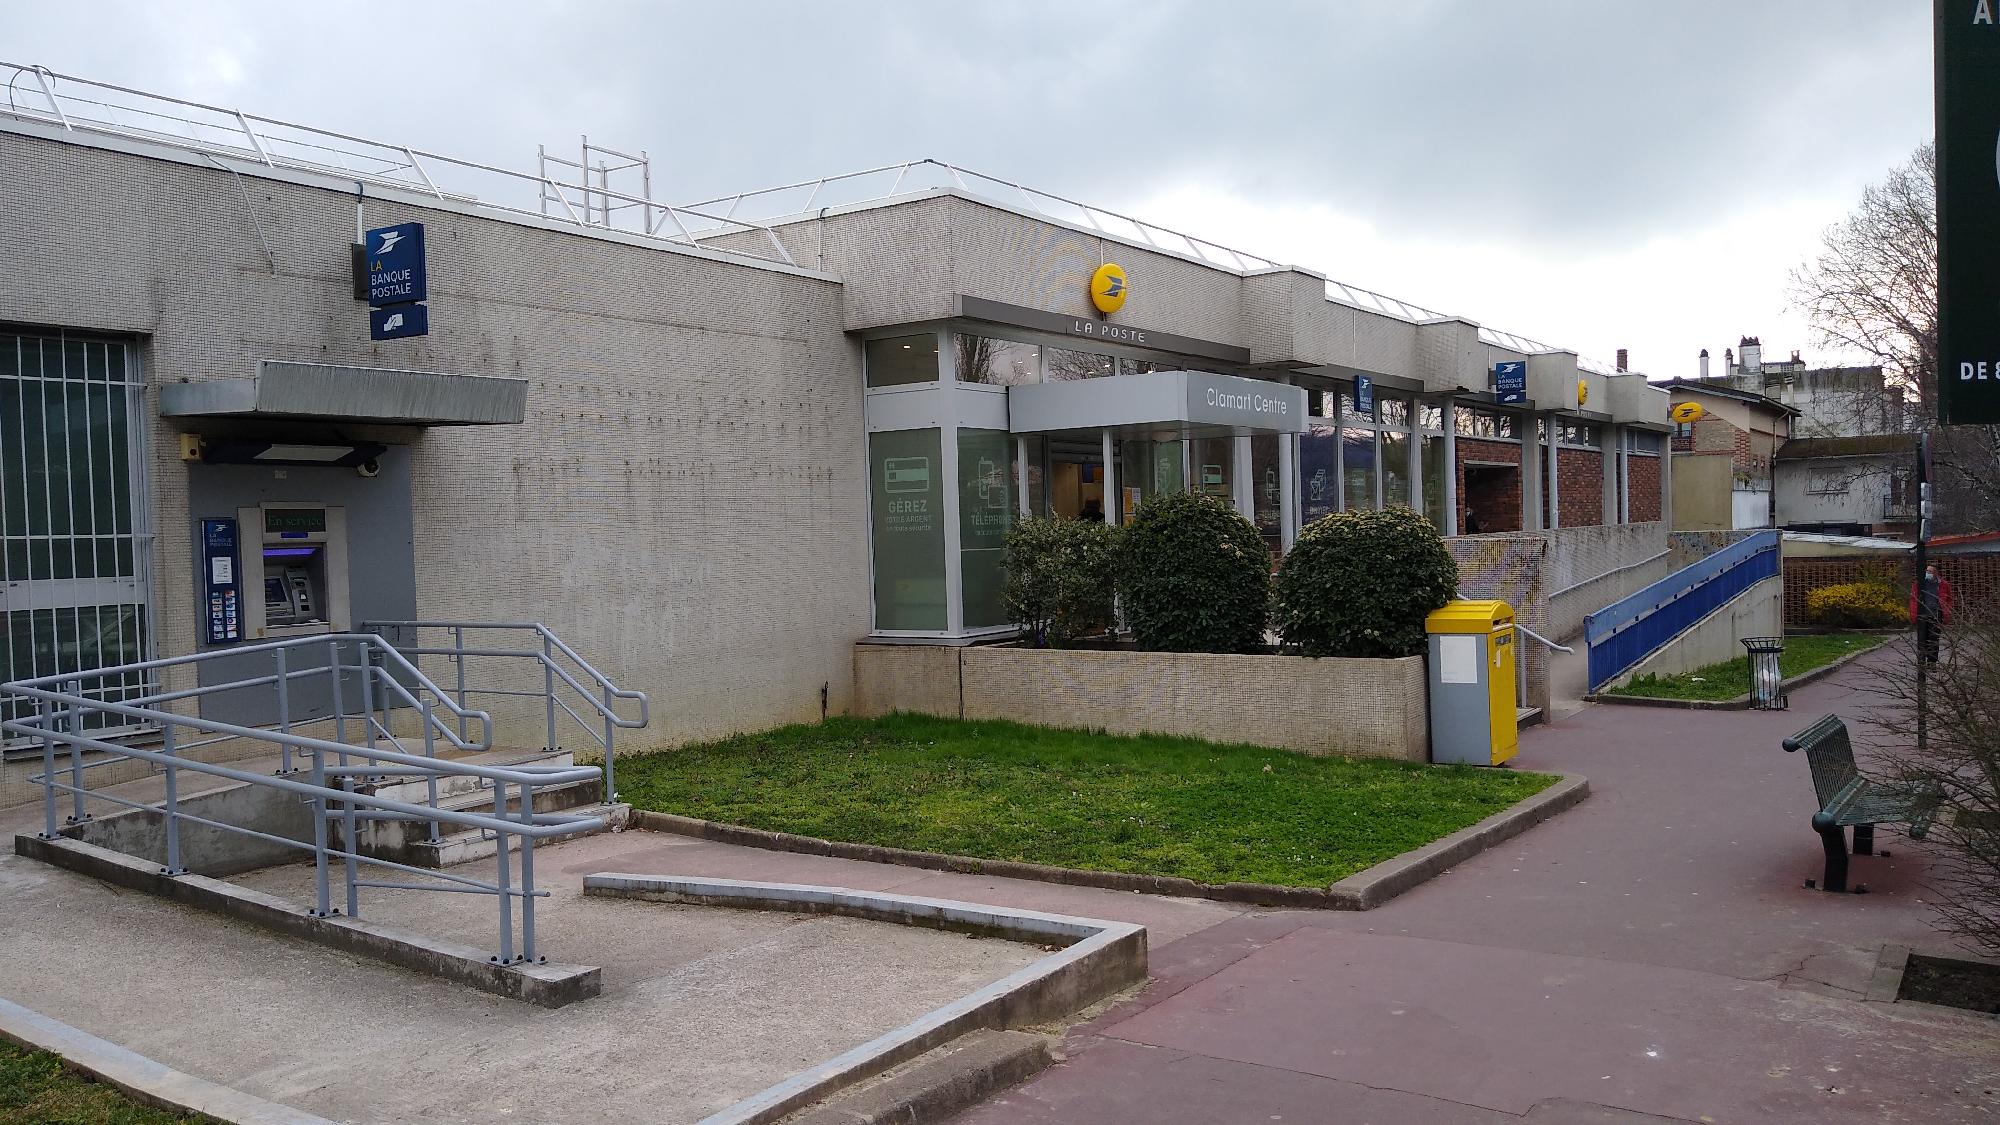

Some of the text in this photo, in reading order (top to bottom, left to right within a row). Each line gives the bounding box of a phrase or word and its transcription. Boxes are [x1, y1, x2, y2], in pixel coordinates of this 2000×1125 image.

[370, 260, 382, 271] LA
[371, 269, 411, 285] BANQUE
[372, 283, 411, 299] POSTALE
[1075, 320, 1145, 342] LA POSTE
[1960, 361, 1988, 380] DE
[1206, 387, 1287, 415] Clamart Centre
[888, 497, 927, 513] GÉREZ
